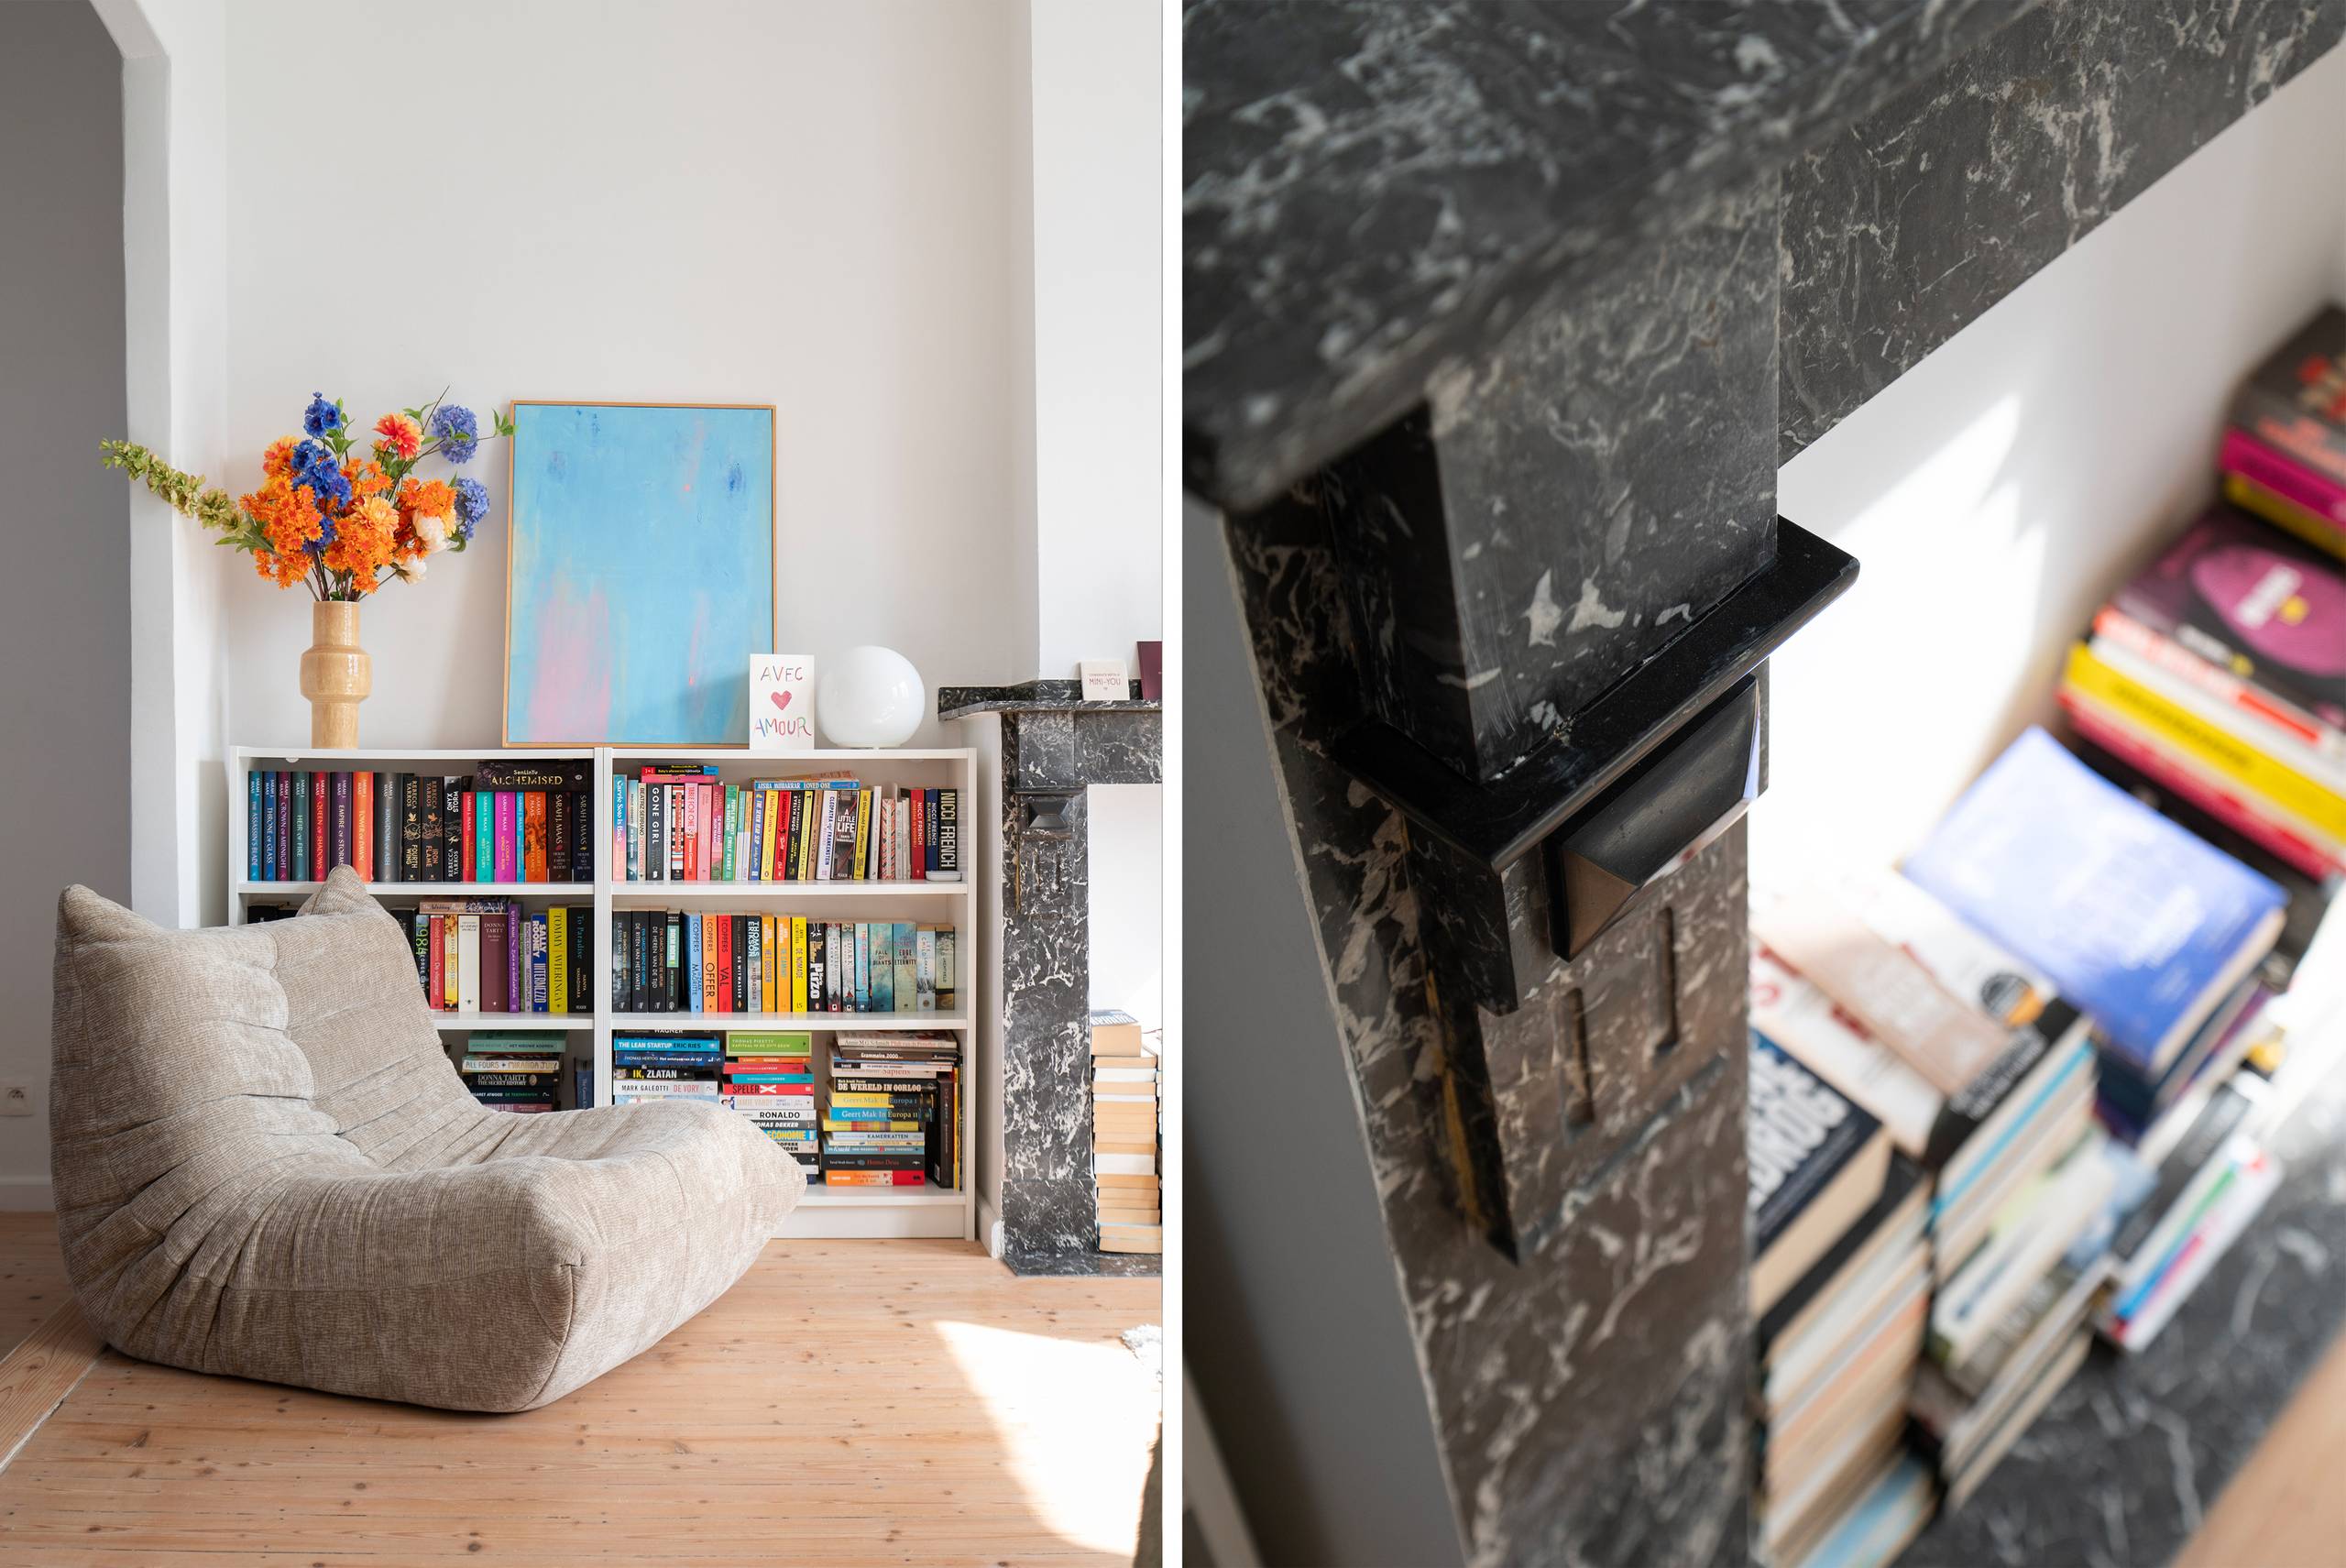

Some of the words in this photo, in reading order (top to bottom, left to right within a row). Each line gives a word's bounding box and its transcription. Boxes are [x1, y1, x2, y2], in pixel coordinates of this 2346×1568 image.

[760, 665, 803, 682] AVEC
[755, 717, 812, 738] AMOUR
[490, 775, 564, 785] ALCHEMISED
[616, 780, 624, 803] Carrie
[652, 787, 660, 817] GONE
[767, 795, 775, 812] Daisy
[940, 792, 956, 820] NICCI
[837, 815, 856, 823] LITTLE
[652, 821, 660, 845] GIRL
[837, 823, 855, 833] LIFE
[940, 826, 956, 867] FRENCH
[577, 916, 585, 925] To
[554, 913, 563, 948] TOMMY
[652, 926, 658, 934] DE
[415, 923, 429, 956] 1984
[532, 920, 540, 959] ROONEY
[554, 953, 563, 1002] WIERINGA
[652, 969, 658, 977] DE
[706, 962, 716, 997] OFFER
[719, 967, 729, 987] VAL
[809, 962, 824, 999] Puzo
[533, 962, 546, 1003] INTERMEZZO
[465, 1061, 477, 1069] ALL
[478, 1061, 499, 1069] FOURS
[632, 1069, 645, 1080] IK,
[646, 1069, 677, 1079] ZLATAN
[673, 1084, 683, 1092] DE
[684, 1084, 700, 1092] VORY
[732, 1085, 760, 1094] SPELER
[838, 1083, 849, 1091] DE
[850, 1083, 882, 1091] WERELD
[889, 1097, 913, 1105] Europa
[887, 1111, 912, 1120] Europa
